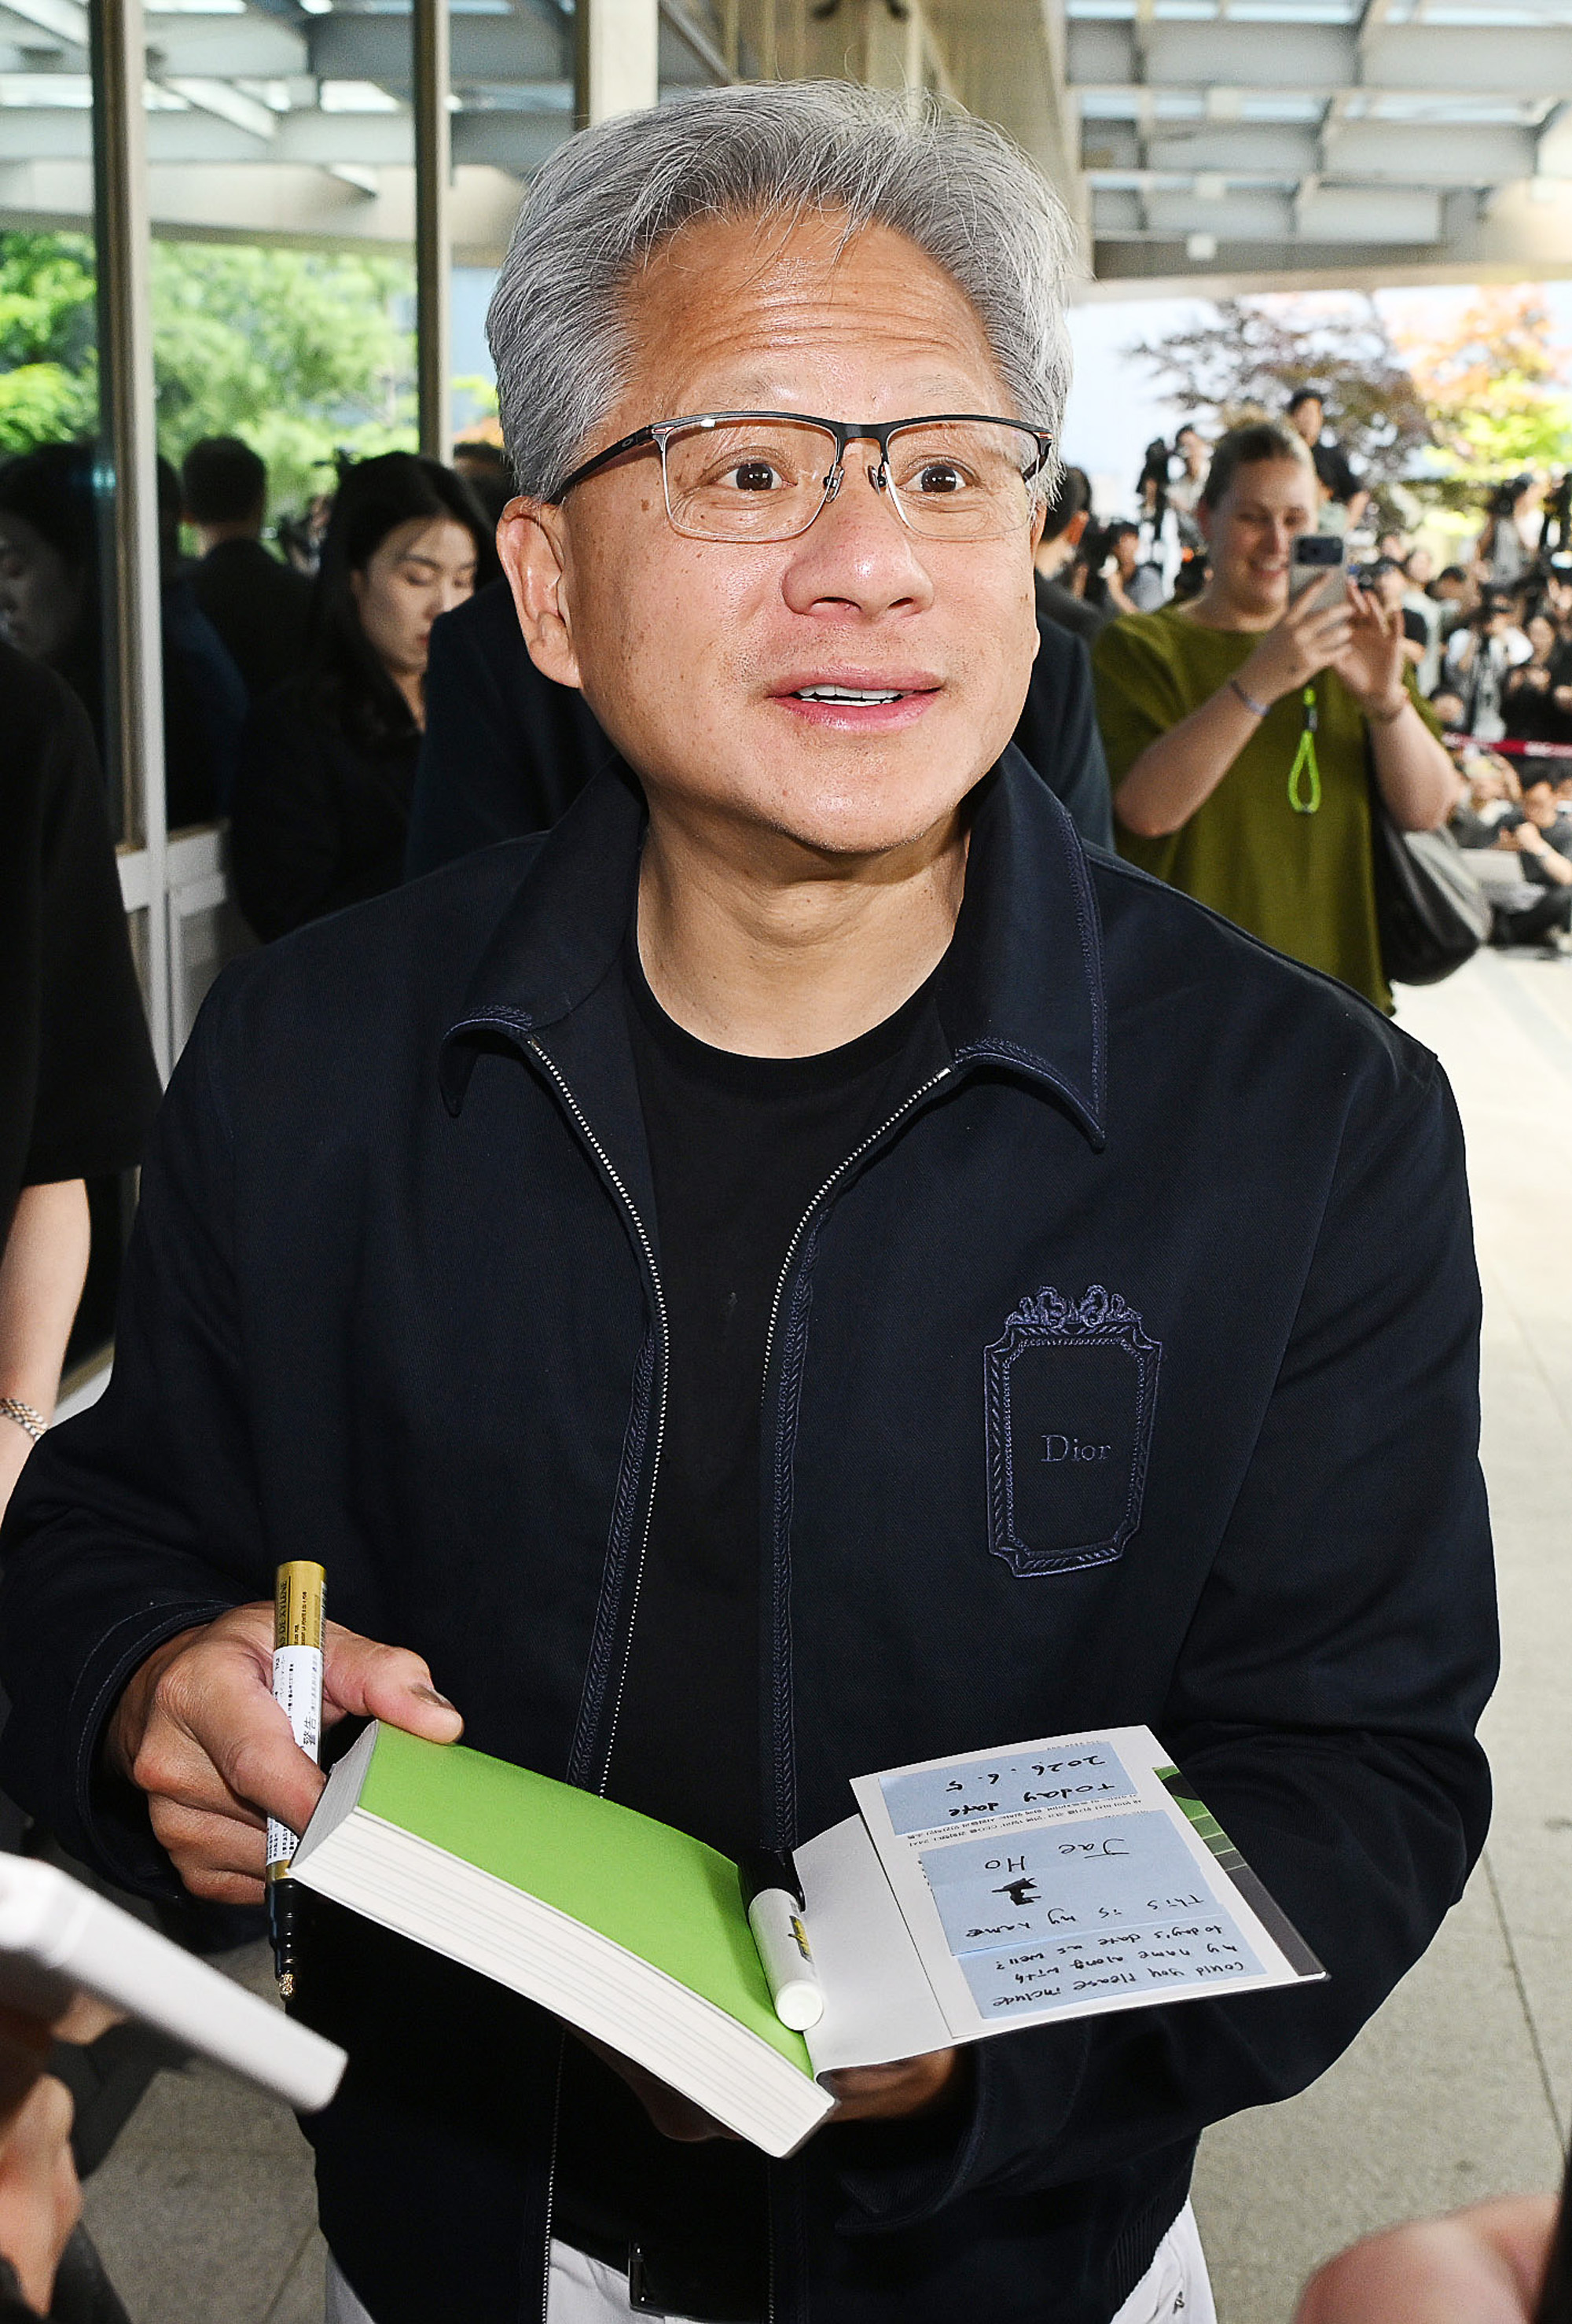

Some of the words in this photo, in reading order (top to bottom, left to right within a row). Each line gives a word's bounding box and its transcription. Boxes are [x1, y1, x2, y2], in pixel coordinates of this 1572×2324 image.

[1040, 1434, 1111, 1462] Dior
[1058, 1838, 1130, 1859] Jae
[984, 1855, 1026, 1873] Ho
[1147, 1894, 1203, 1910] This
[1047, 1907, 1077, 1925] my
[1098, 1907, 1122, 1919] is
[965, 1921, 1031, 1938] name
[1097, 1933, 1141, 1946] date
[1137, 1948, 1191, 1959] name
[1207, 1943, 1238, 1953] my
[1147, 1968, 1185, 1978] you
[1196, 1962, 1243, 1977] Could
[993, 1987, 1061, 2006] include
